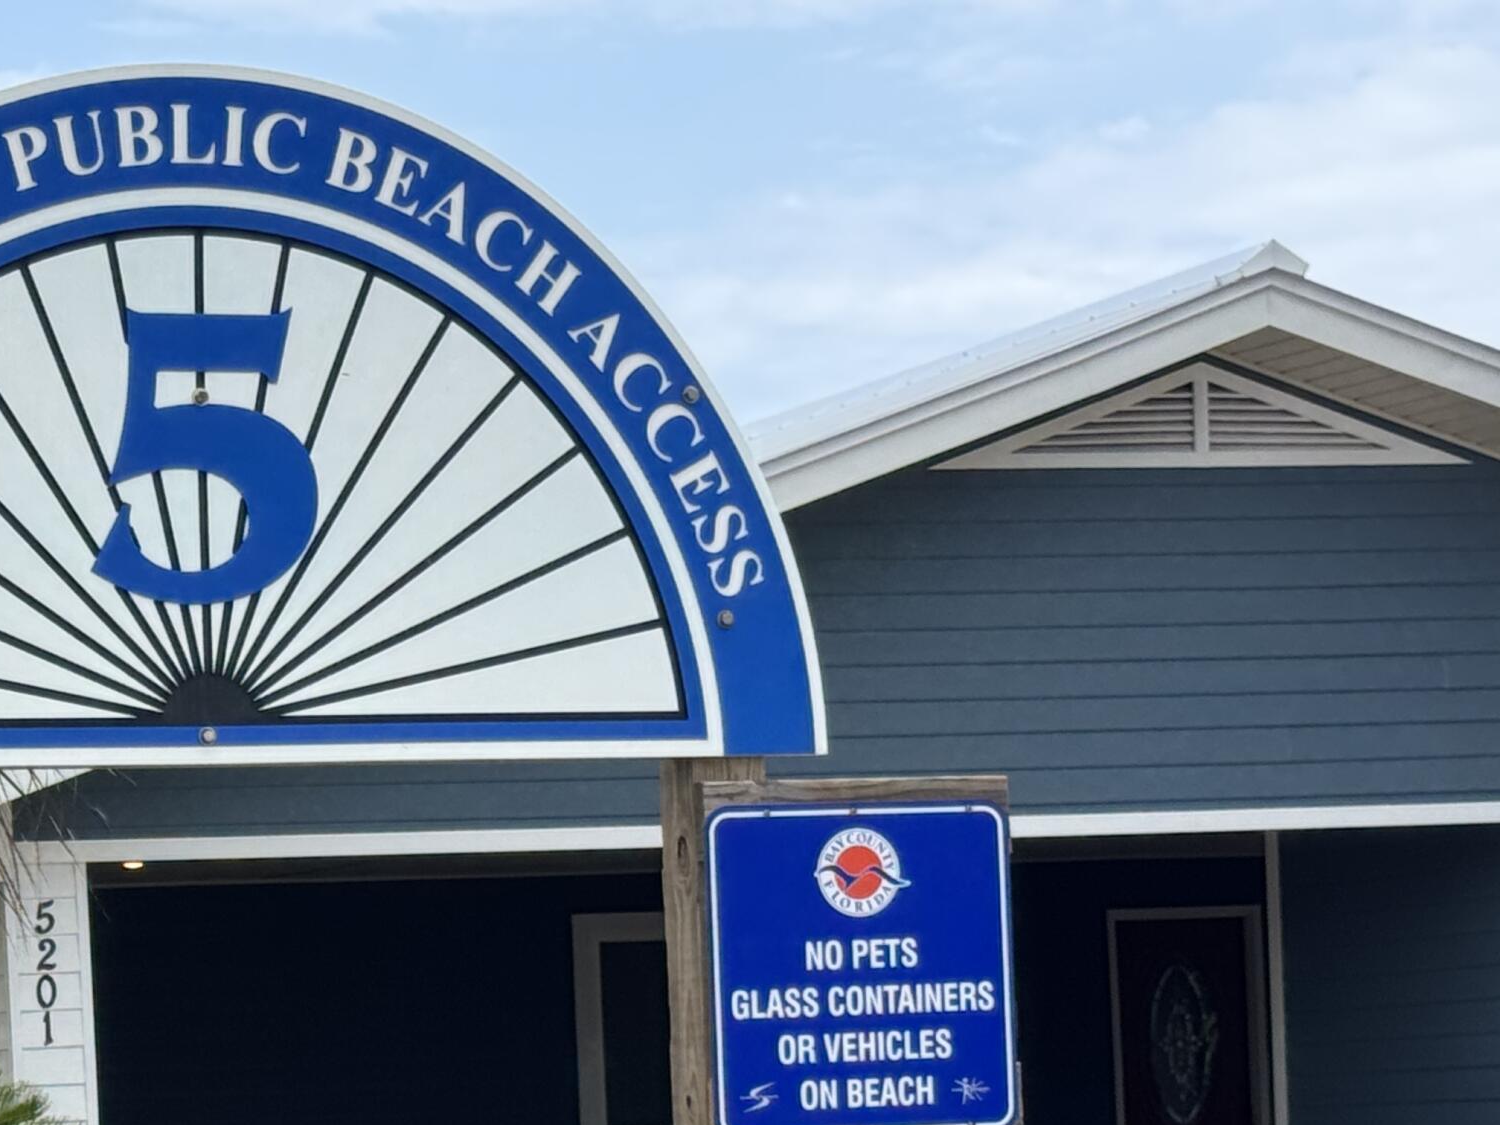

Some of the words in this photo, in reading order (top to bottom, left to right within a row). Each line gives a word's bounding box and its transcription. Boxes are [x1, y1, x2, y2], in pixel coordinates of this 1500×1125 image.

[2, 104, 306, 192] PUBLIC
[325, 127, 582, 316] BEACH
[567, 313, 764, 598] ACCESS
[90, 306, 318, 605] 5
[824, 836, 845, 863] BAY
[846, 832, 894, 870] COUNTY
[824, 880, 892, 913] FLORIDA
[35, 899, 57, 1046] 5201
[805, 939, 843, 971] NO
[852, 937, 918, 969] PETS
[731, 987, 820, 1020] GLASS
[828, 981, 995, 1017] CONTAINERS
[778, 1034, 816, 1065] OR
[823, 1028, 952, 1062] VEHICLES
[800, 1079, 838, 1111] ON
[847, 1076, 934, 1109] BEACH
